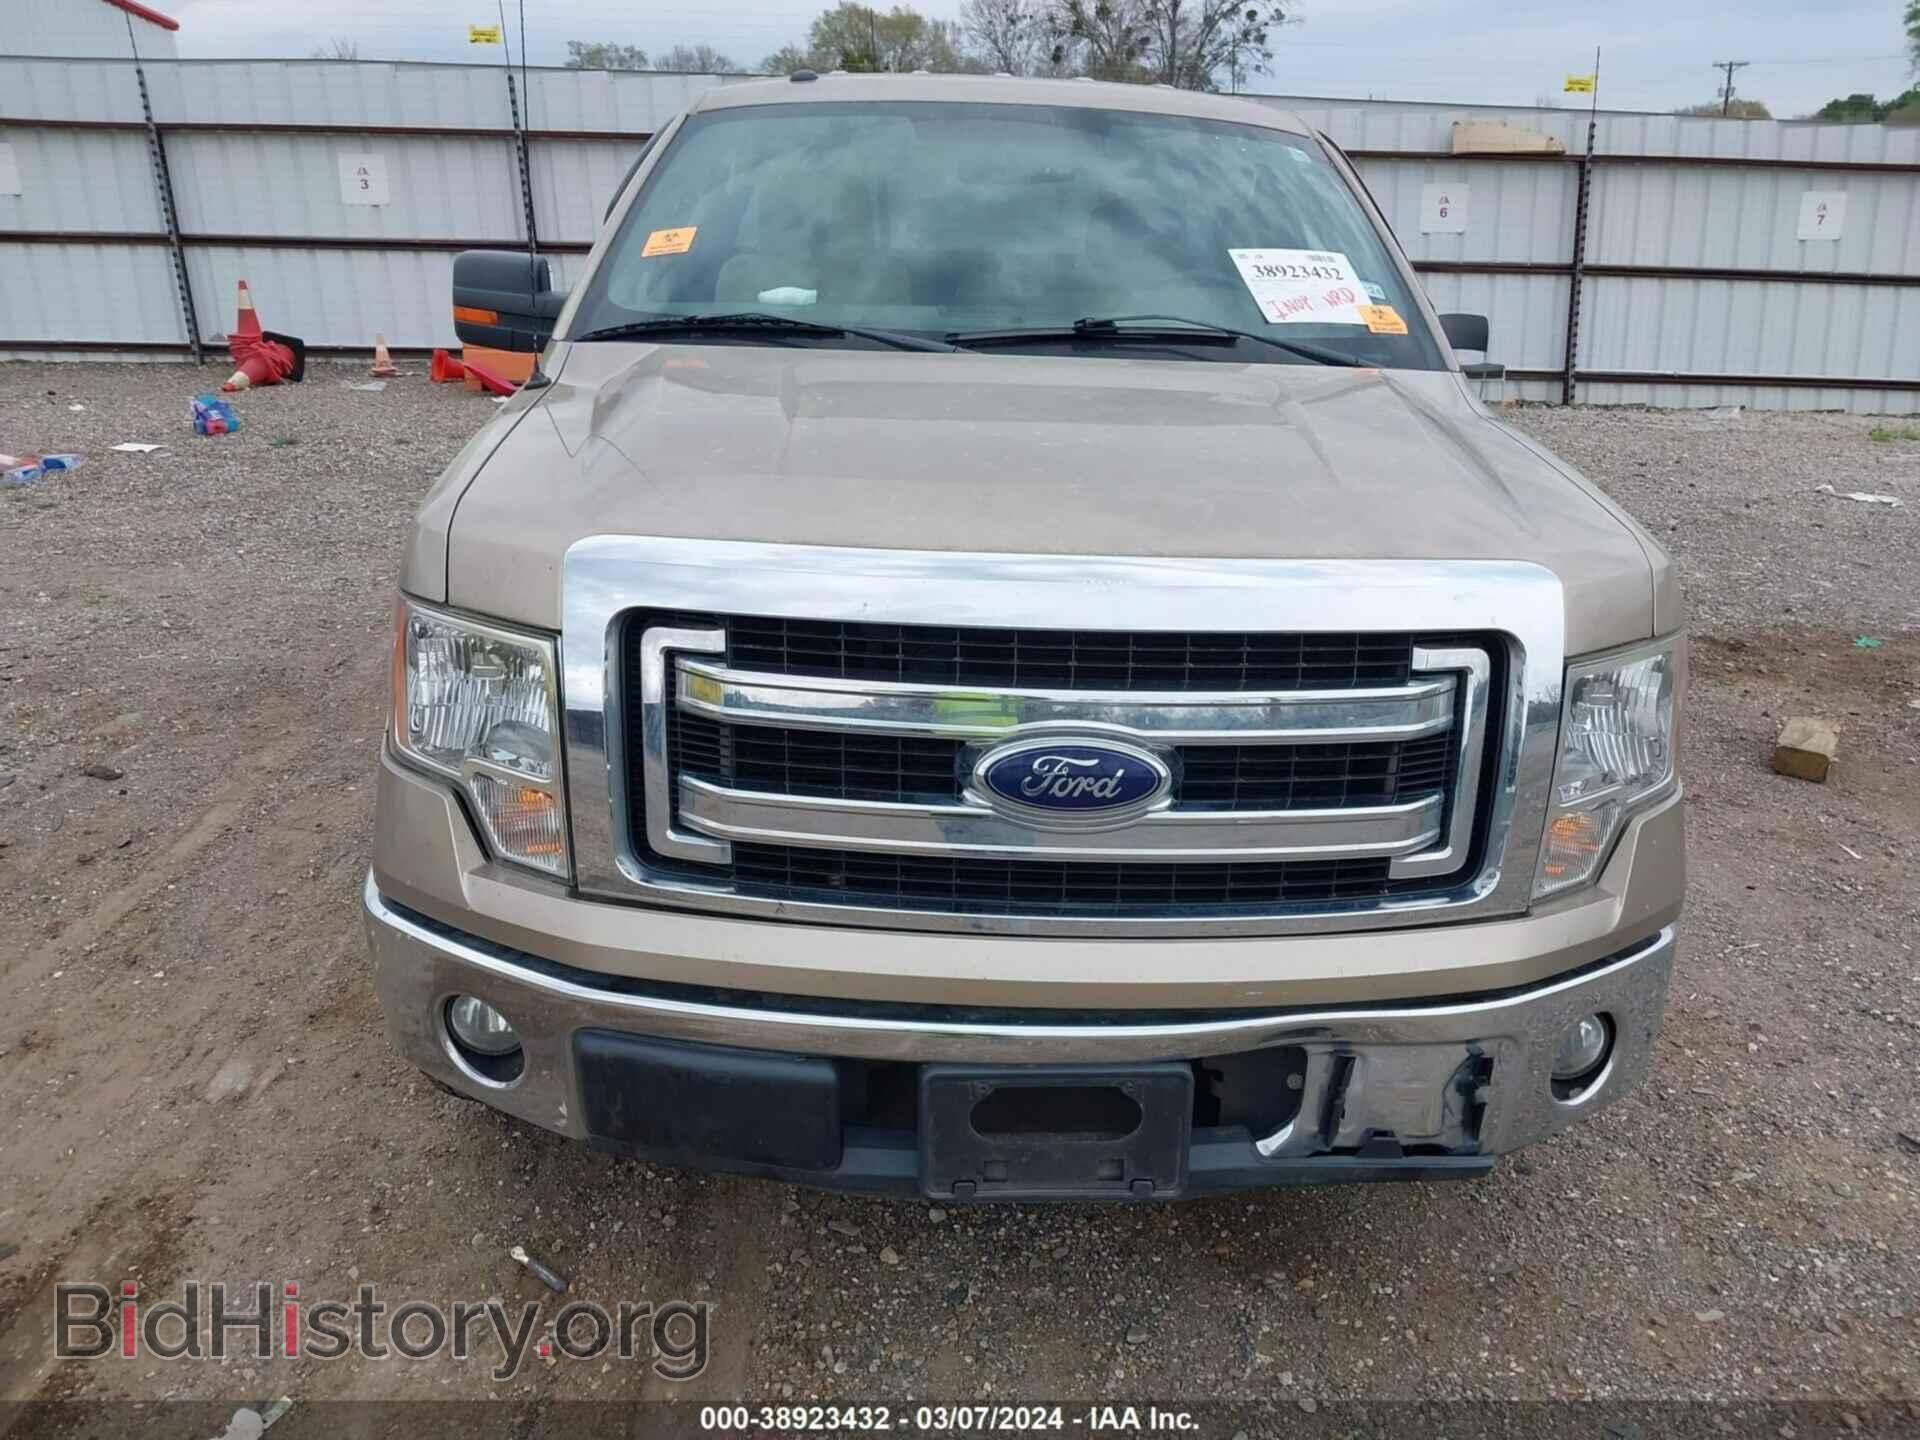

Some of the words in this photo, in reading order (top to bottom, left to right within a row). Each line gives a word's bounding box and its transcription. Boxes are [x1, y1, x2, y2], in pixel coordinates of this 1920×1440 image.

[359, 177, 370, 190] 3
[1439, 206, 1449, 219] 6
[1816, 213, 1826, 226] 7
[1252, 264, 1345, 281] 38923432
[1021, 754, 1126, 799] Ford
